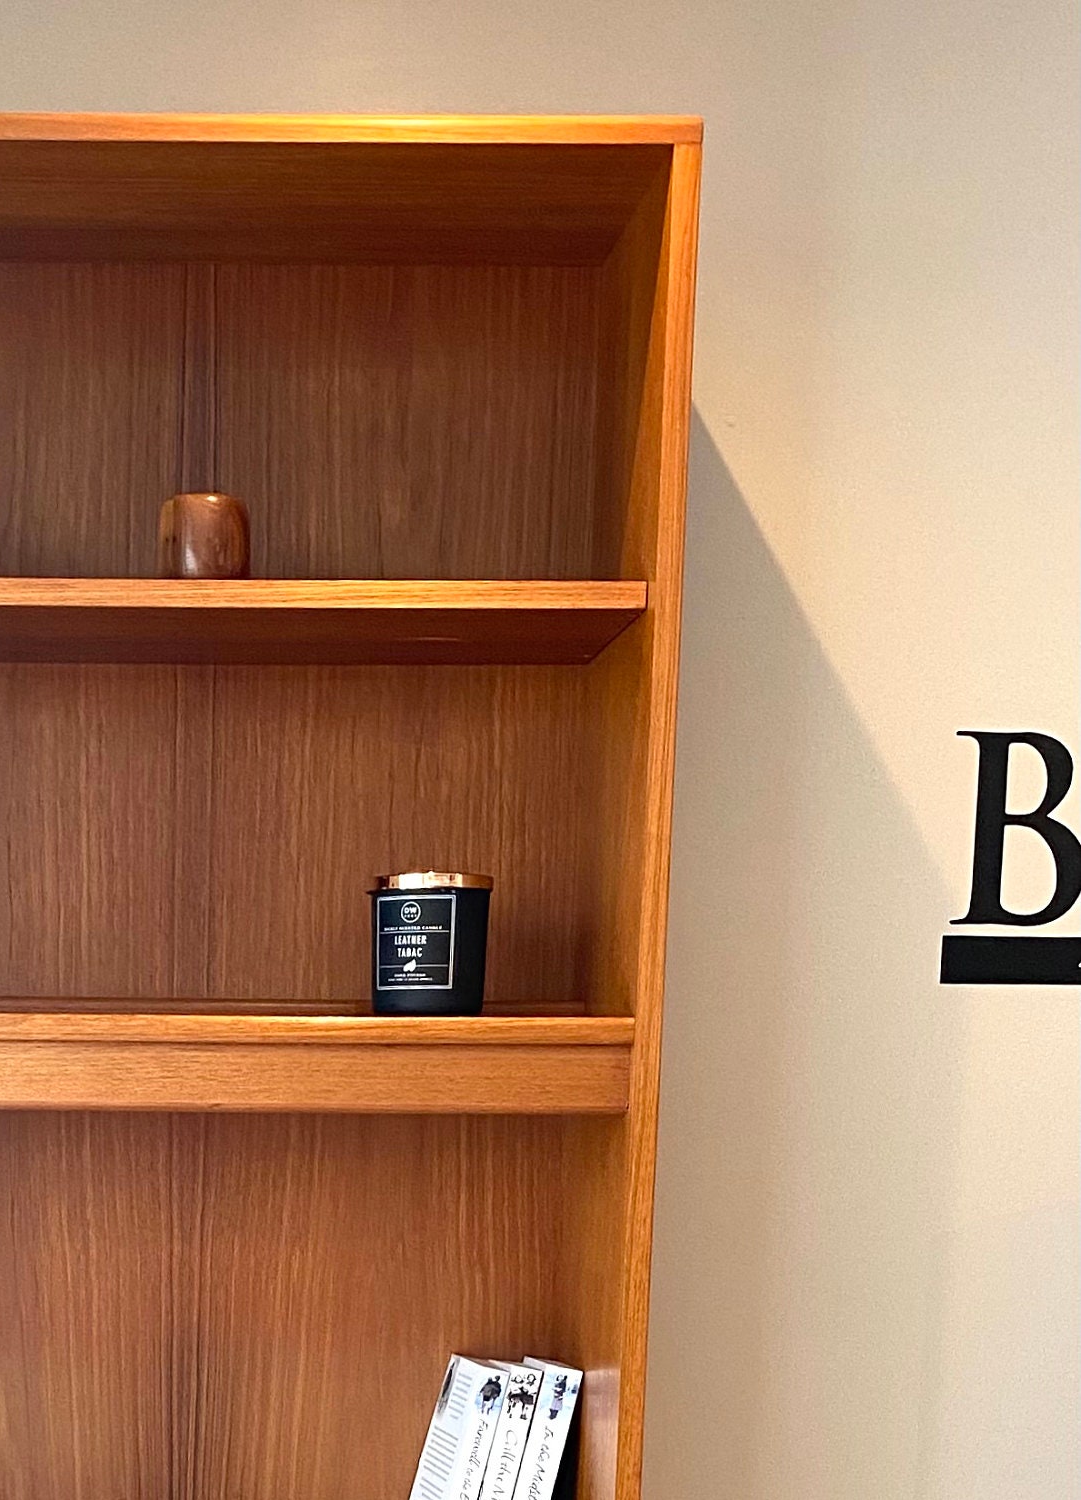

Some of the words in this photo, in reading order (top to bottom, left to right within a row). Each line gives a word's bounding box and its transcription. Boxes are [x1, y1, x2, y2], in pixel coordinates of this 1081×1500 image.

[394, 935, 427, 945] LEATHER
[397, 947, 423, 958] TABAC
[469, 1419, 489, 1468] Farewell
[500, 1429, 518, 1462] Call
[538, 1443, 550, 1463] the
[495, 1462, 512, 1481] the
